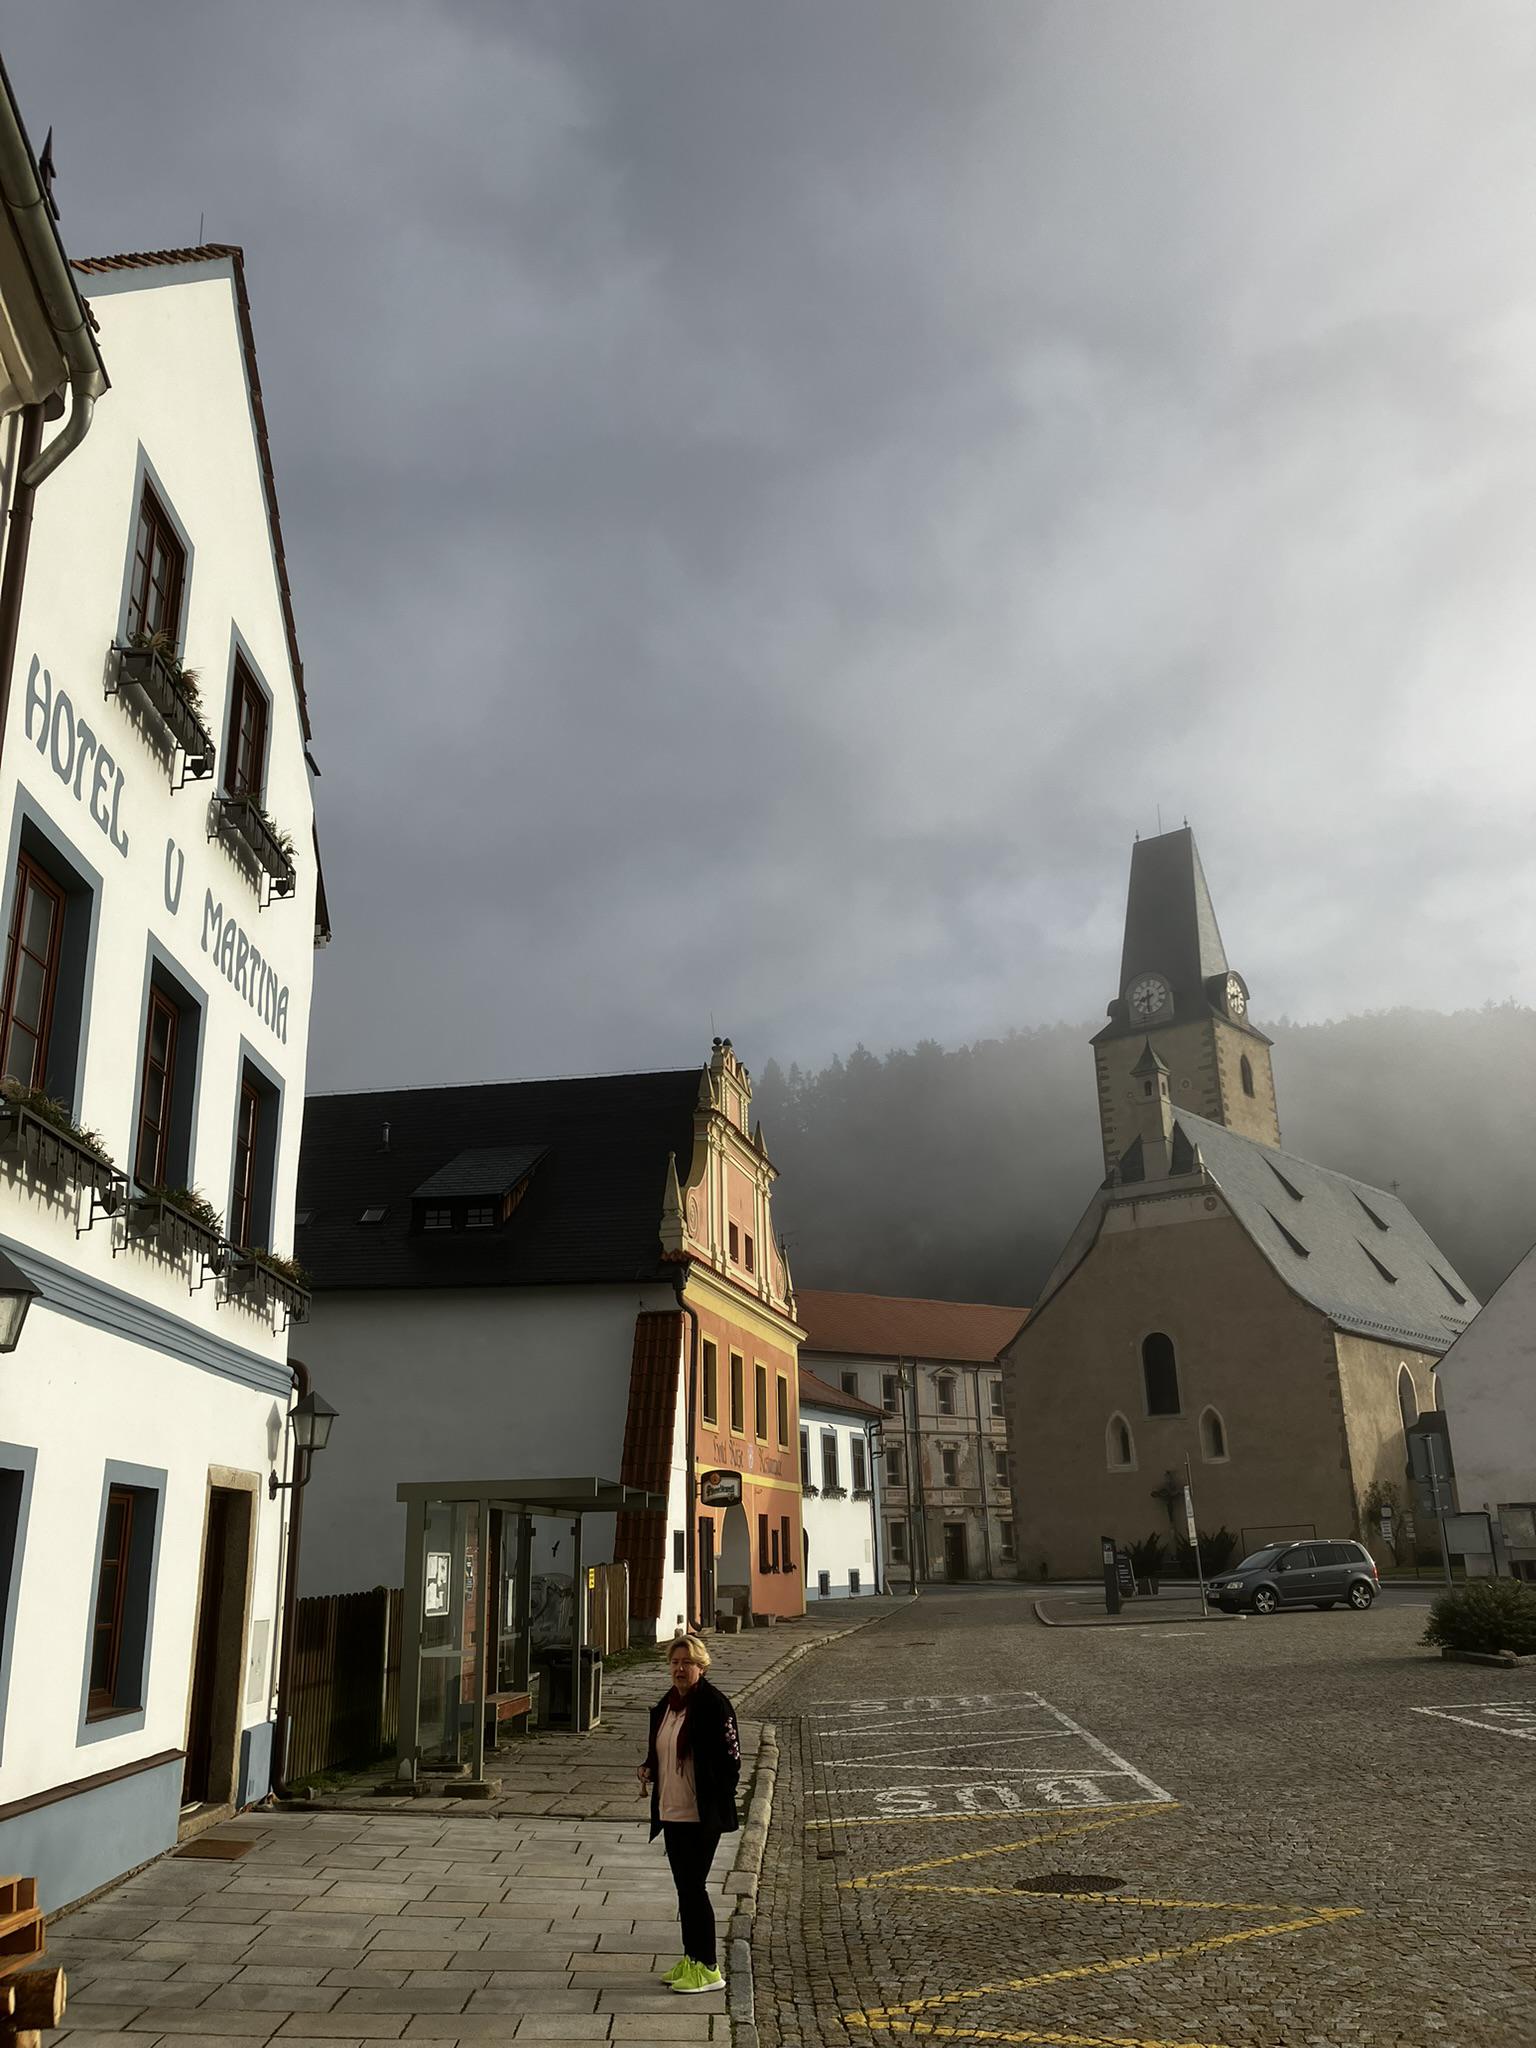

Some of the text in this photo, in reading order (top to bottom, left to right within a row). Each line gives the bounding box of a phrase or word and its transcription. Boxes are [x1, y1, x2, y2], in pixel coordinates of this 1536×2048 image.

[25, 652, 290, 1045] HOTEL U MARTINA
[874, 1779, 1113, 1813] BUS
